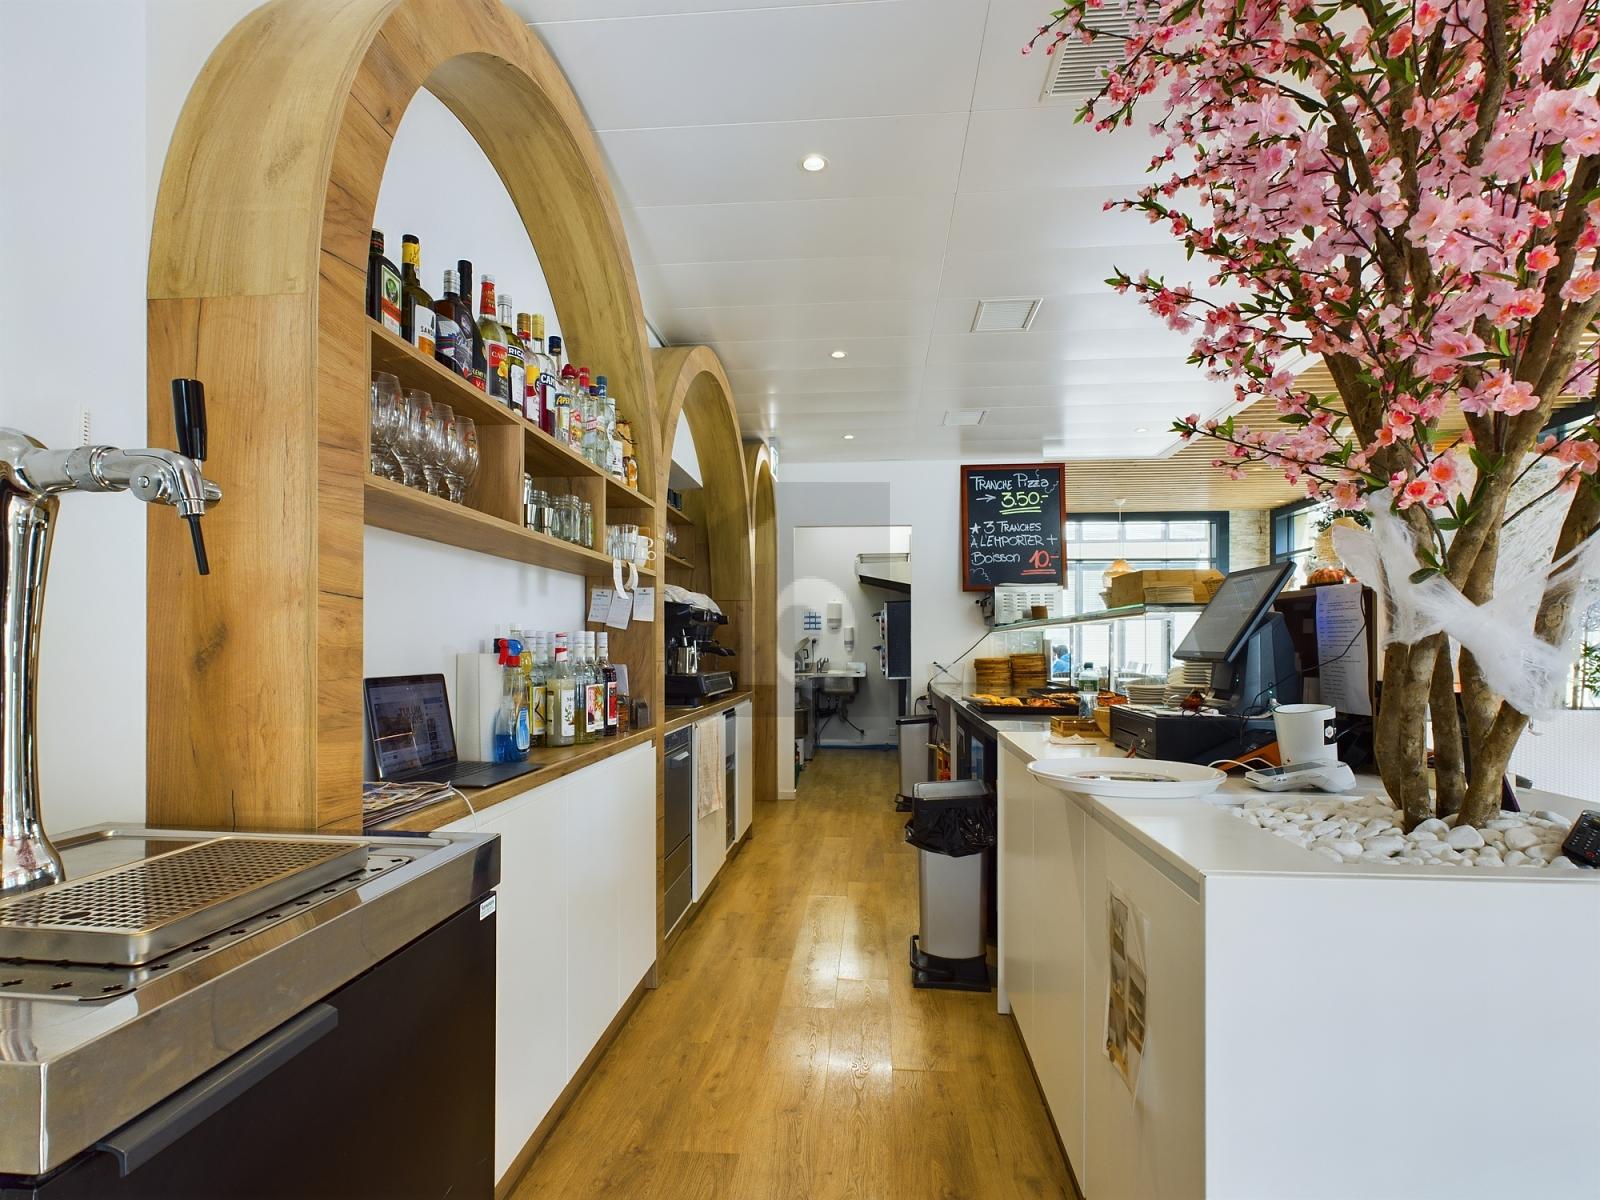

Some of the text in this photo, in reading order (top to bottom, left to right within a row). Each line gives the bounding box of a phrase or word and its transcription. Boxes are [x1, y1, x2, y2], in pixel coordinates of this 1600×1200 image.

[969, 476, 1013, 491] TRANCHE
[983, 521, 1042, 534] 3 TRANCHES
[971, 551, 1021, 565] Boisson
